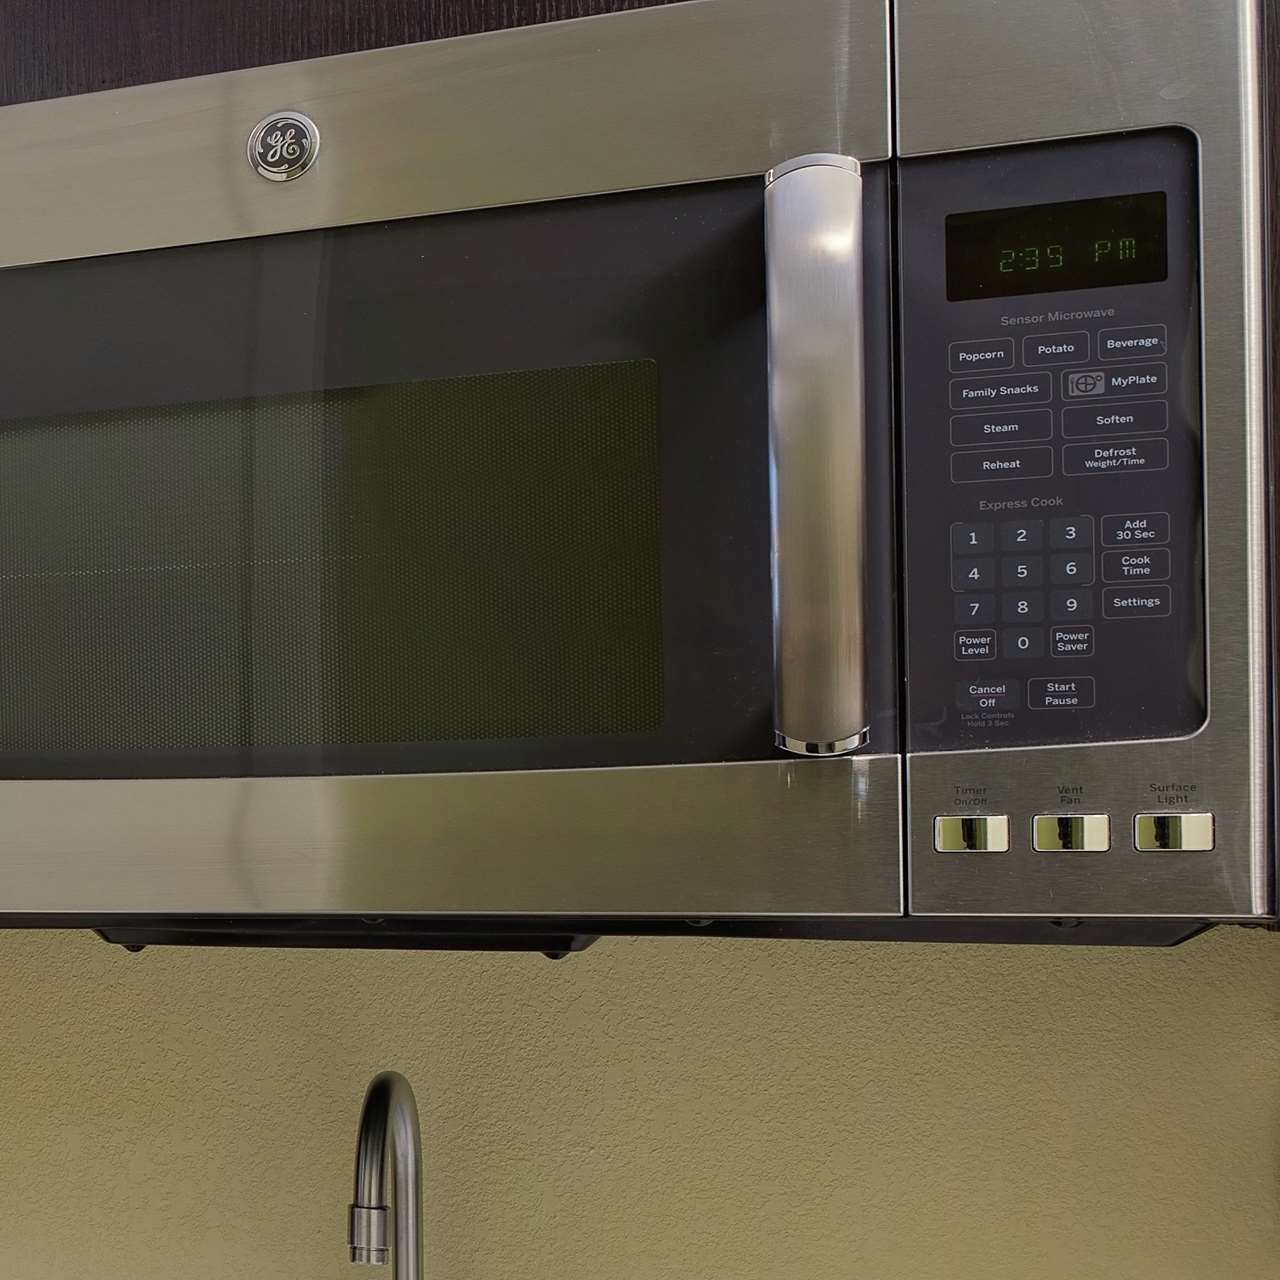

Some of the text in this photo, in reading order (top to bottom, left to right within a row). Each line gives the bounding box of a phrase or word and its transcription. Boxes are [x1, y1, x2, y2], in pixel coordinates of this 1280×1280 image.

[1000, 238, 1136, 272] 2:35 PM
[1000, 307, 1115, 327] Sensor Microwave
[1037, 343, 1075, 355] Potato
[1106, 336, 1159, 350] Beverage
[958, 350, 1005, 363] Popcorn
[1111, 374, 1158, 388] MyPlate
[962, 383, 1040, 400] Family Snacks
[1096, 414, 1134, 425] Soften
[983, 422, 1019, 433] Steam
[1094, 446, 1137, 458] Defrost
[982, 459, 1021, 470] Reheat
[1084, 457, 1146, 469] Weight/Time
[979, 496, 1063, 512] Express Cook
[1124, 519, 1147, 529] Add
[968, 532, 978, 545] 1
[1016, 529, 1027, 542] 2
[1065, 526, 1077, 539] 3
[1116, 529, 1156, 540] 30 Sec
[1121, 556, 1151, 565] Cook
[968, 568, 980, 580] 4
[1017, 565, 1028, 578] 5
[1065, 562, 1077, 575] 6
[1122, 566, 1151, 575] Time
[1017, 601, 1029, 614] 8
[1066, 599, 1078, 611] 9
[1113, 597, 1161, 608] Settings
[969, 603, 980, 616] 7
[959, 635, 991, 645] Power
[1055, 631, 1089, 641] Power
[1018, 637, 1029, 649] 0
[1057, 642, 1089, 651] Saver
[961, 646, 989, 655] Level
[969, 684, 1006, 694] Cancel
[1047, 682, 1076, 692] Start
[979, 698, 996, 708] Off
[1045, 696, 1078, 705] Pause
[954, 785, 988, 795] Timer
[1057, 785, 1084, 795] Vent
[1149, 783, 1197, 793] Surface
[1060, 795, 1081, 804] Fan
[1156, 793, 1189, 806] Light
